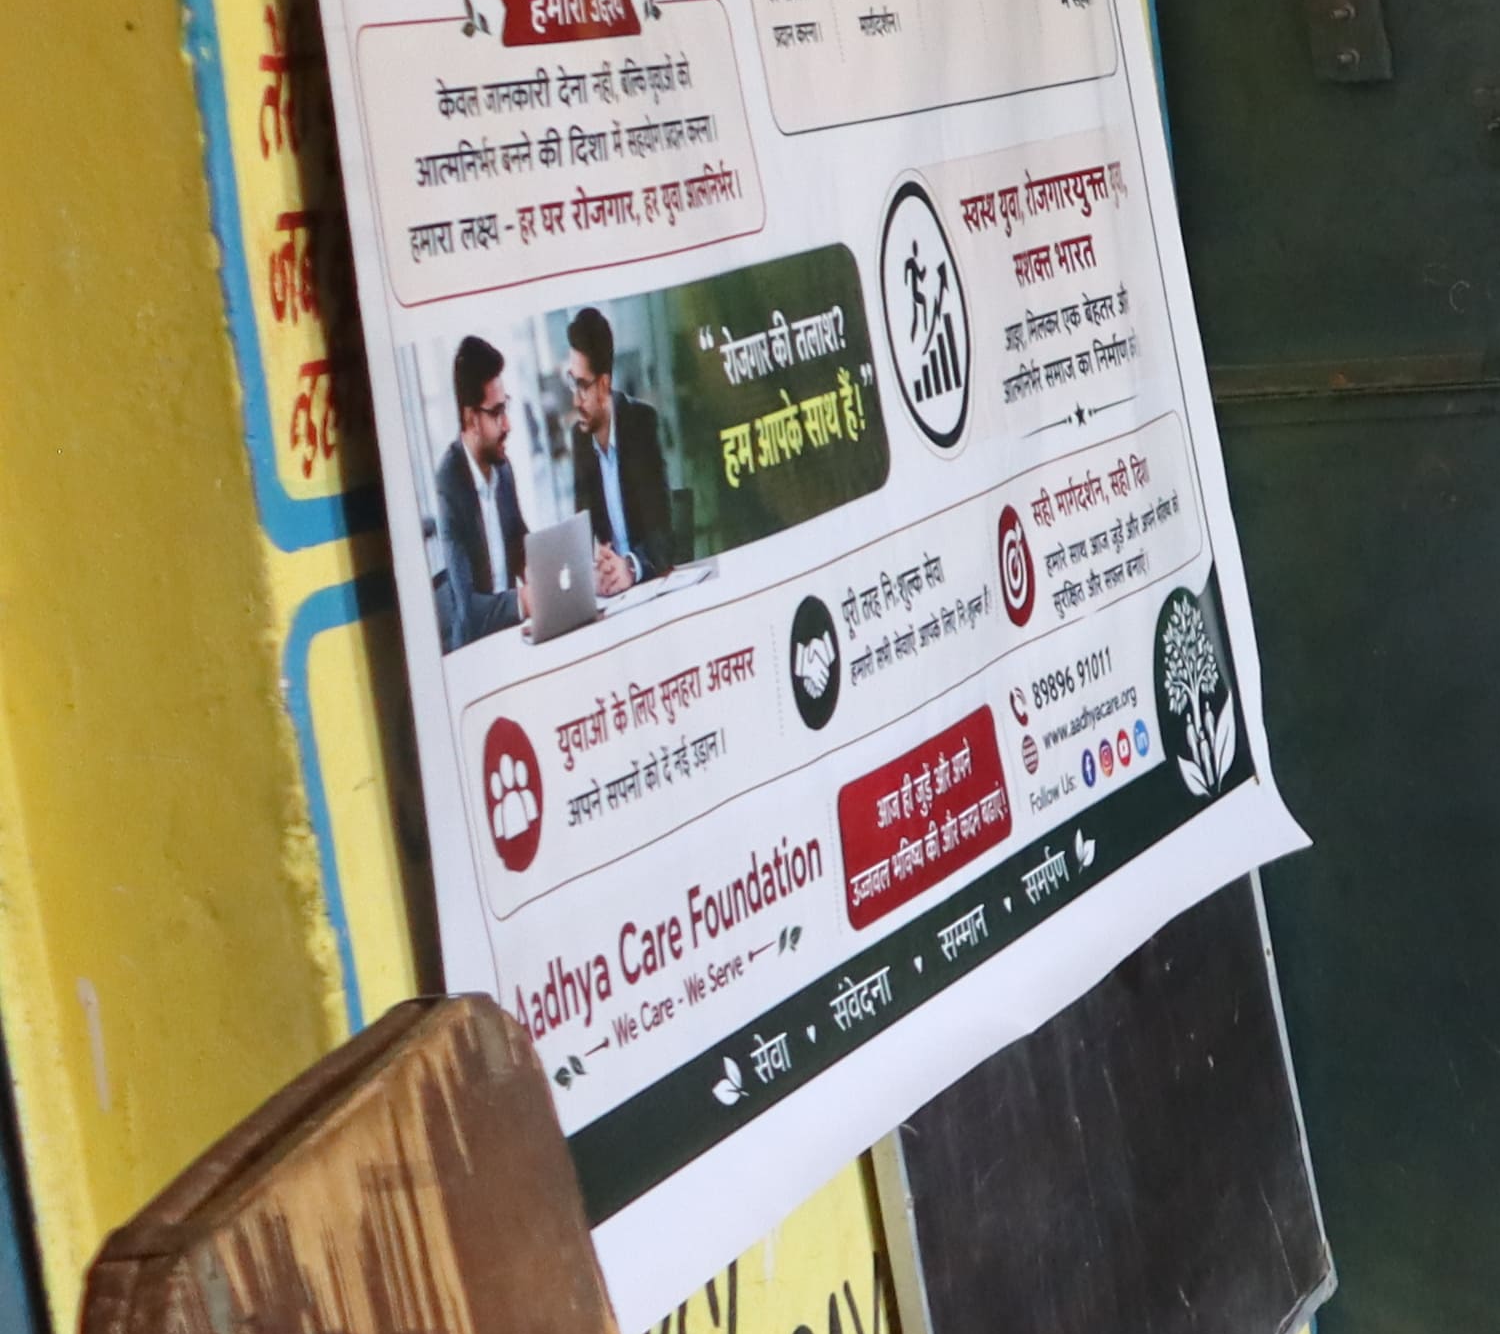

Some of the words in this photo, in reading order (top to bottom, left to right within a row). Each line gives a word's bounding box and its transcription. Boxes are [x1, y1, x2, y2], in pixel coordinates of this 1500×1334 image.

[408, 222, 455, 264] हमारा
[459, 211, 499, 253] लक्ष्य
[517, 207, 537, 246] हर
[541, 203, 566, 237] घर
[571, 187, 641, 232] रोजगार,
[642, 189, 661, 224] हर
[719, 326, 774, 385] रोजगार
[767, 309, 795, 372] की
[719, 421, 755, 489] हम
[754, 387, 804, 468] आपके
[800, 390, 843, 449] साथ
[556, 696, 609, 769] युवाओं
[611, 690, 630, 733] के
[629, 683, 659, 728] लिए
[659, 664, 702, 727] सुनहरा
[705, 646, 757, 692] अवसर
[1031, 663, 1077, 711] 89896
[1077, 646, 1114, 690] 91011
[1042, 684, 1139, 750] www.aadhyacare.org
[1028, 777, 1062, 816] Follow
[1060, 771, 1078, 803] Us:
[514, 944, 613, 1043] Aadhya
[617, 916, 683, 986] Care
[687, 835, 824, 950] Foundation
[750, 1032, 793, 1085] सेवा
[829, 964, 894, 1031] संवेदना
[937, 903, 989, 961] सम्मान
[1021, 849, 1070, 906] समर्पण
[611, 1012, 638, 1049] We
[639, 997, 676, 1035] Care
[684, 975, 708, 1007] We
[708, 957, 746, 1001] Serve
